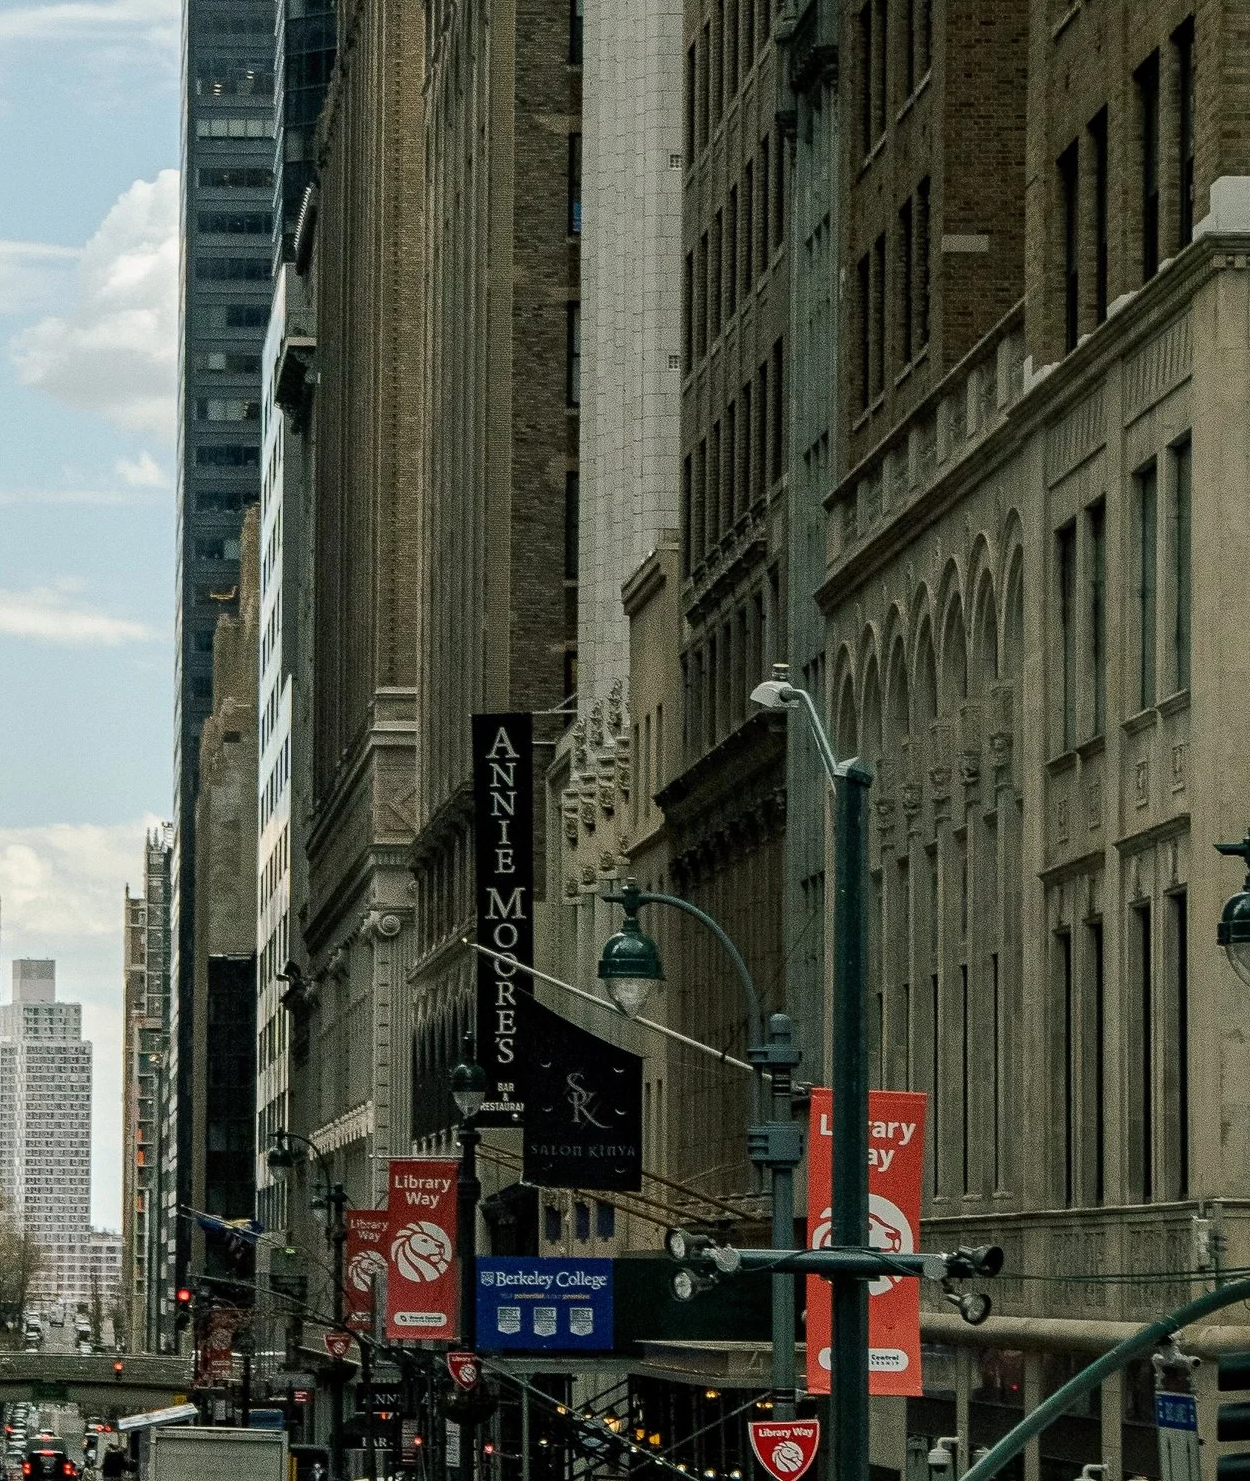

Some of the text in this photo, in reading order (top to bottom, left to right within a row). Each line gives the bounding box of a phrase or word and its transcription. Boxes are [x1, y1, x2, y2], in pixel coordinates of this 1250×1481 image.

[485, 727, 520, 874] ANNIE
[485, 887, 527, 1064] MOORE'S
[497, 1082, 515, 1092] BAR
[820, 1113, 916, 1146] Lary
[531, 1144, 582, 1157] SALON
[867, 1148, 895, 1172] ay
[395, 1175, 452, 1193] Library
[405, 1192, 440, 1209] Way
[350, 1218, 389, 1232] Library
[358, 1230, 382, 1242] Way
[495, 1270, 607, 1290] Berkeley College
[758, 1426, 813, 1440] Library Way
